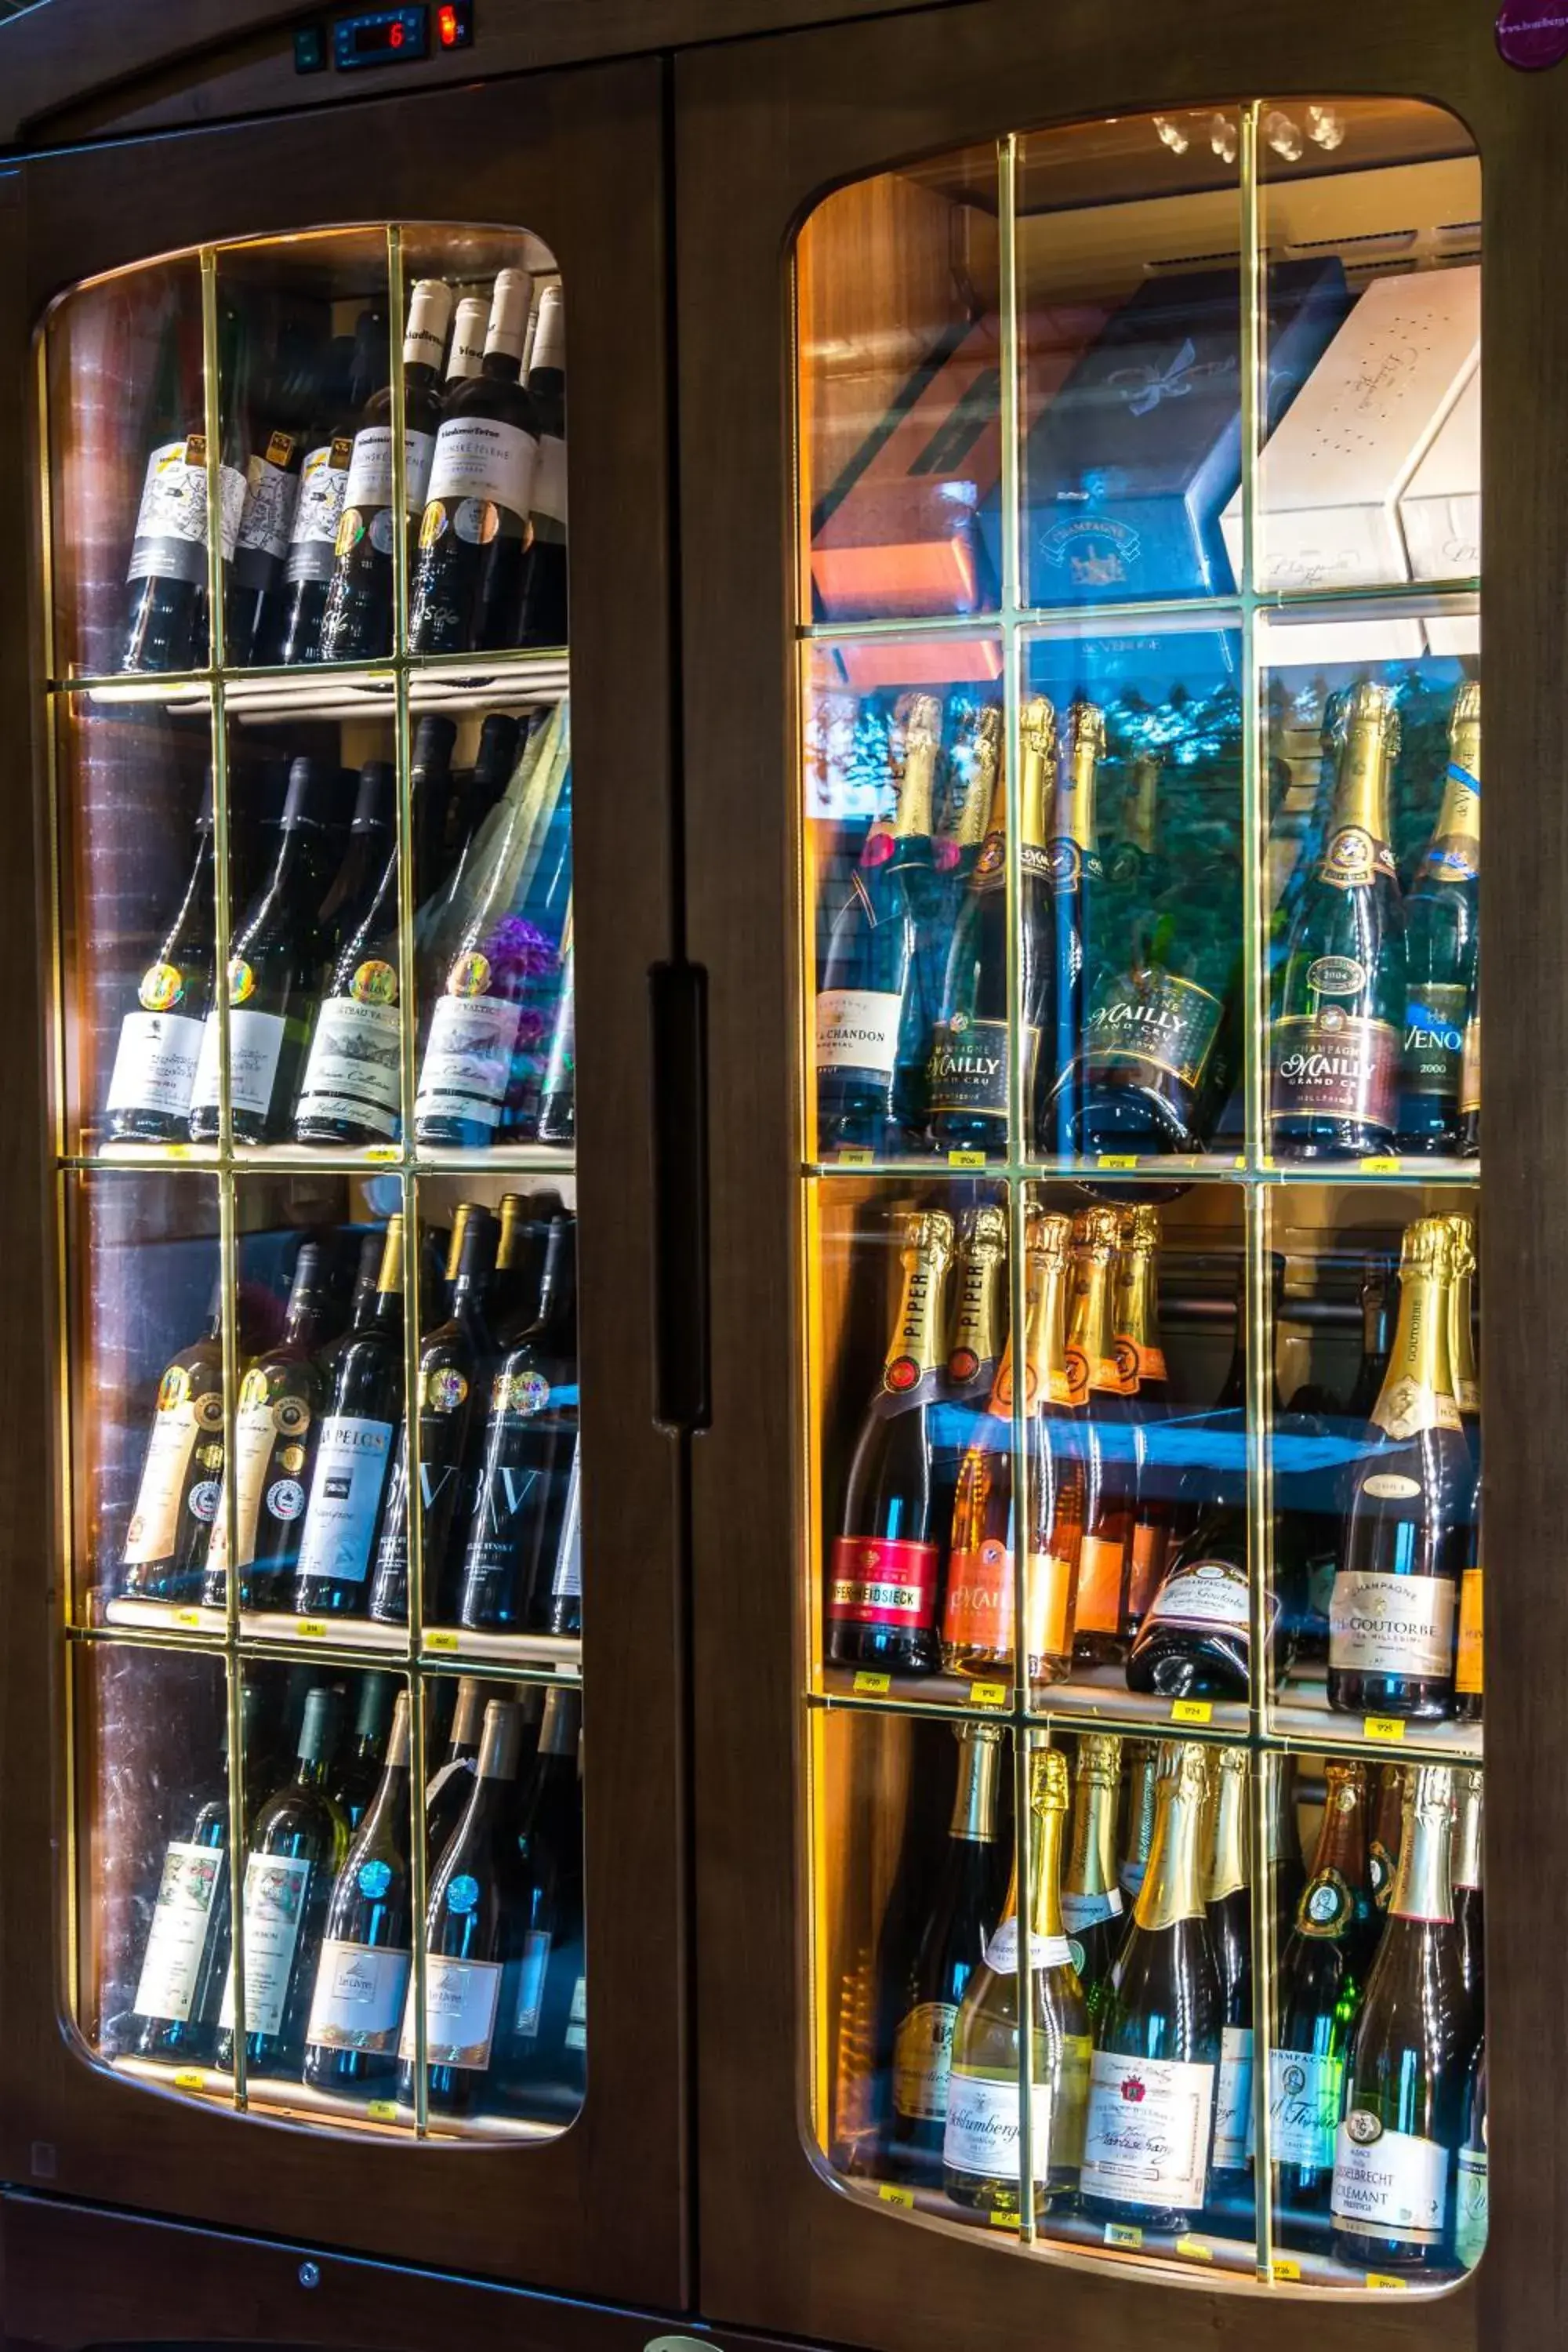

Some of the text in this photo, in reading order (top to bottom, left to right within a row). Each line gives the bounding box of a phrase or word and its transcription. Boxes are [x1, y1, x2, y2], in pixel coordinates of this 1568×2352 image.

[390, 23, 405, 48] 6
[826, 1028, 885, 1042] CHANDON
[927, 1054, 1000, 1077] MAILLY
[1280, 1053, 1377, 1080] MAILLY
[903, 1273, 929, 1338] PIPER
[960, 1265, 985, 1327] PIPER
[1352, 1581, 1418, 1602] CHAMPAGNE
[1349, 1617, 1438, 1638] GOUTORBE
